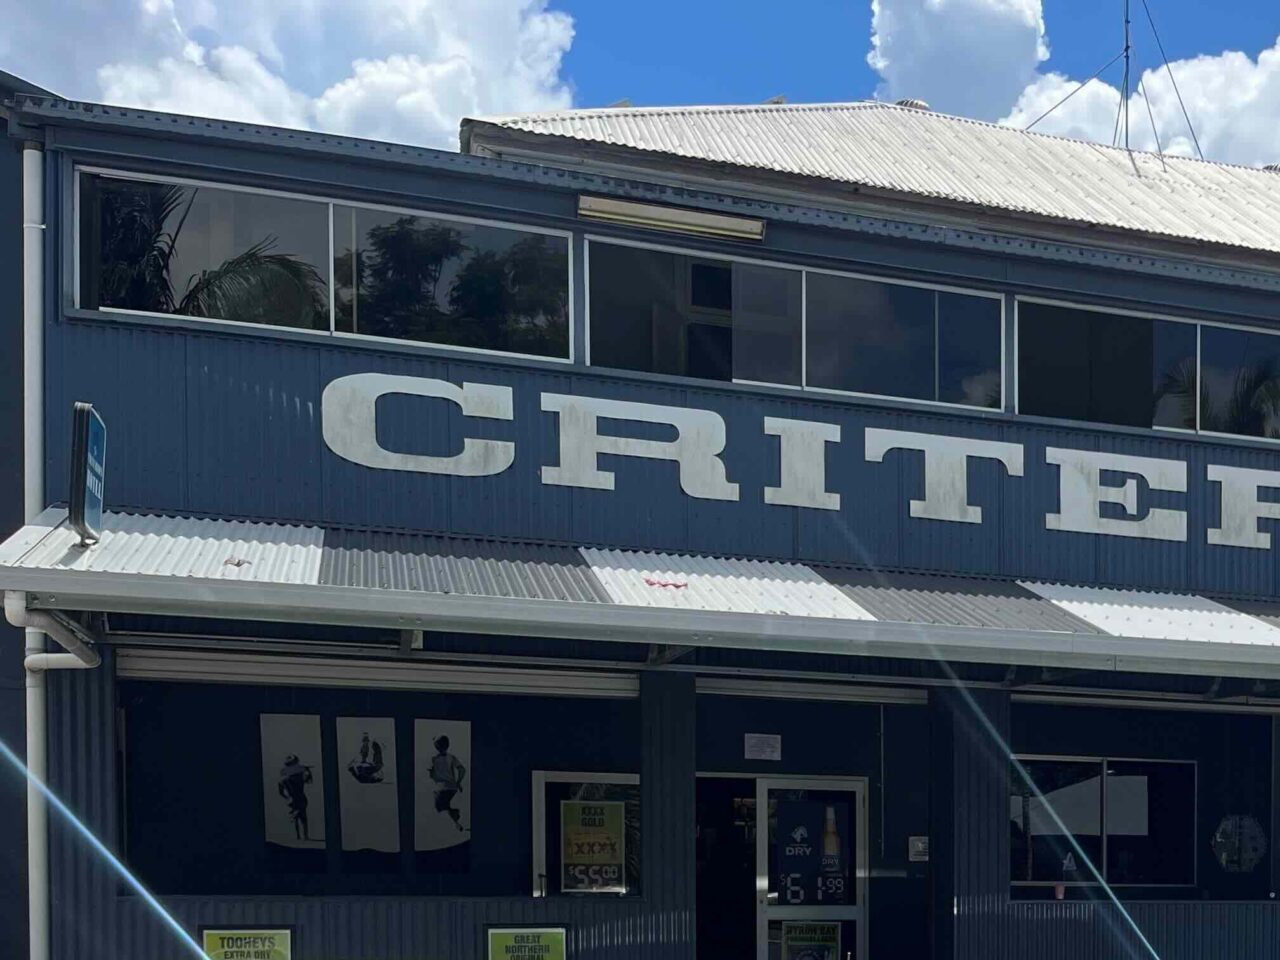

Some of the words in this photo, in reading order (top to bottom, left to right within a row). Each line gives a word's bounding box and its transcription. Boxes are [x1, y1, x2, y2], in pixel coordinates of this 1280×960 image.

[581, 817, 604, 827] GOLD
[785, 847, 813, 856] DRY
[219, 936, 276, 949] TOOHEYS
[514, 934, 541, 944] GREAT
[505, 944, 550, 954] NORTHERN
[224, 951, 251, 960] EXTRA
[254, 950, 271, 960] DRY
